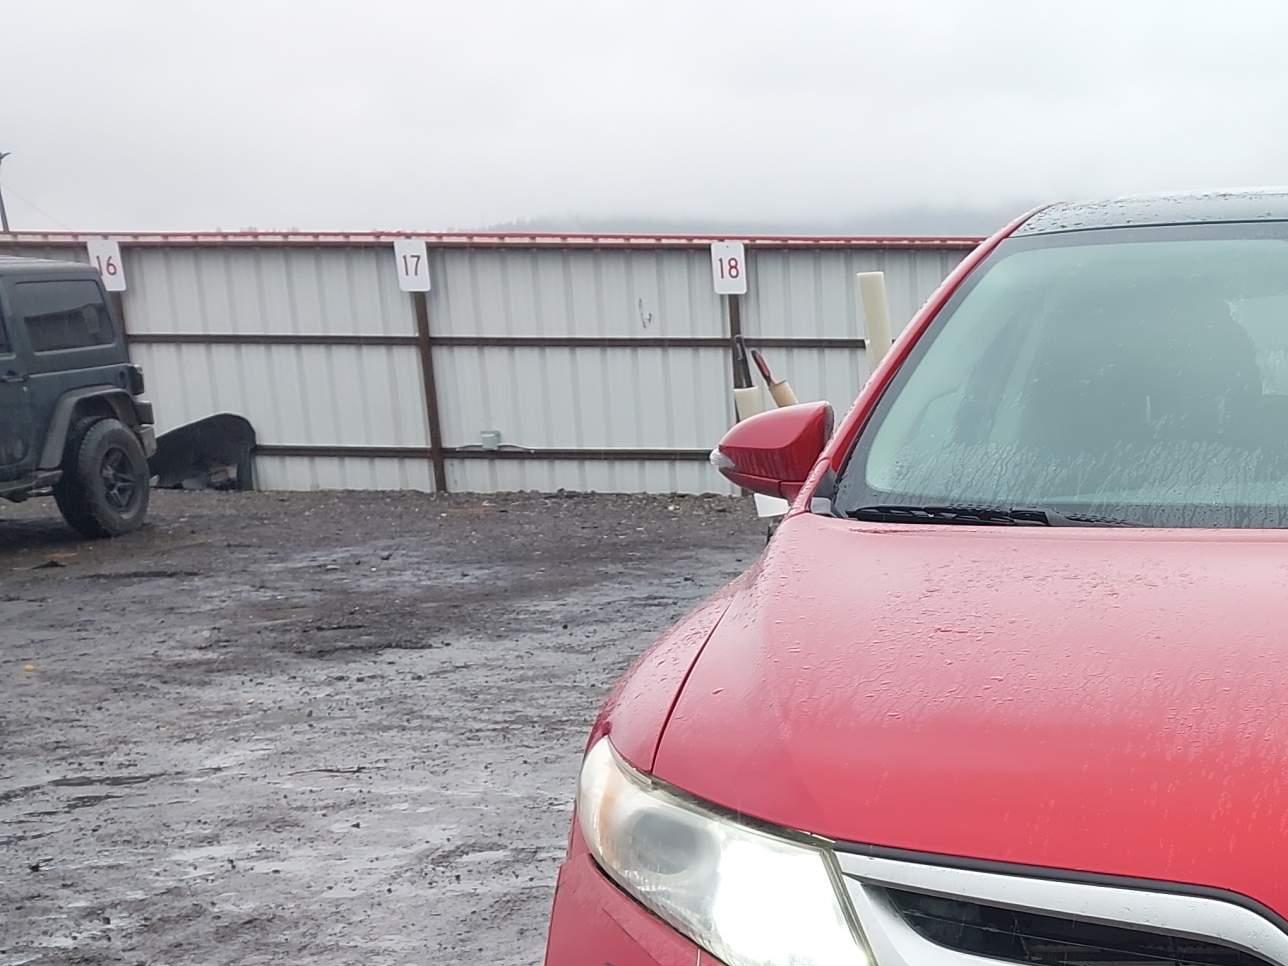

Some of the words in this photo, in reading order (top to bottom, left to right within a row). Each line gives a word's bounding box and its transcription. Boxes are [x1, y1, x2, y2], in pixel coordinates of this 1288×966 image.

[96, 255, 117, 276] 16
[402, 254, 421, 277] 17
[718, 256, 740, 279] 18
